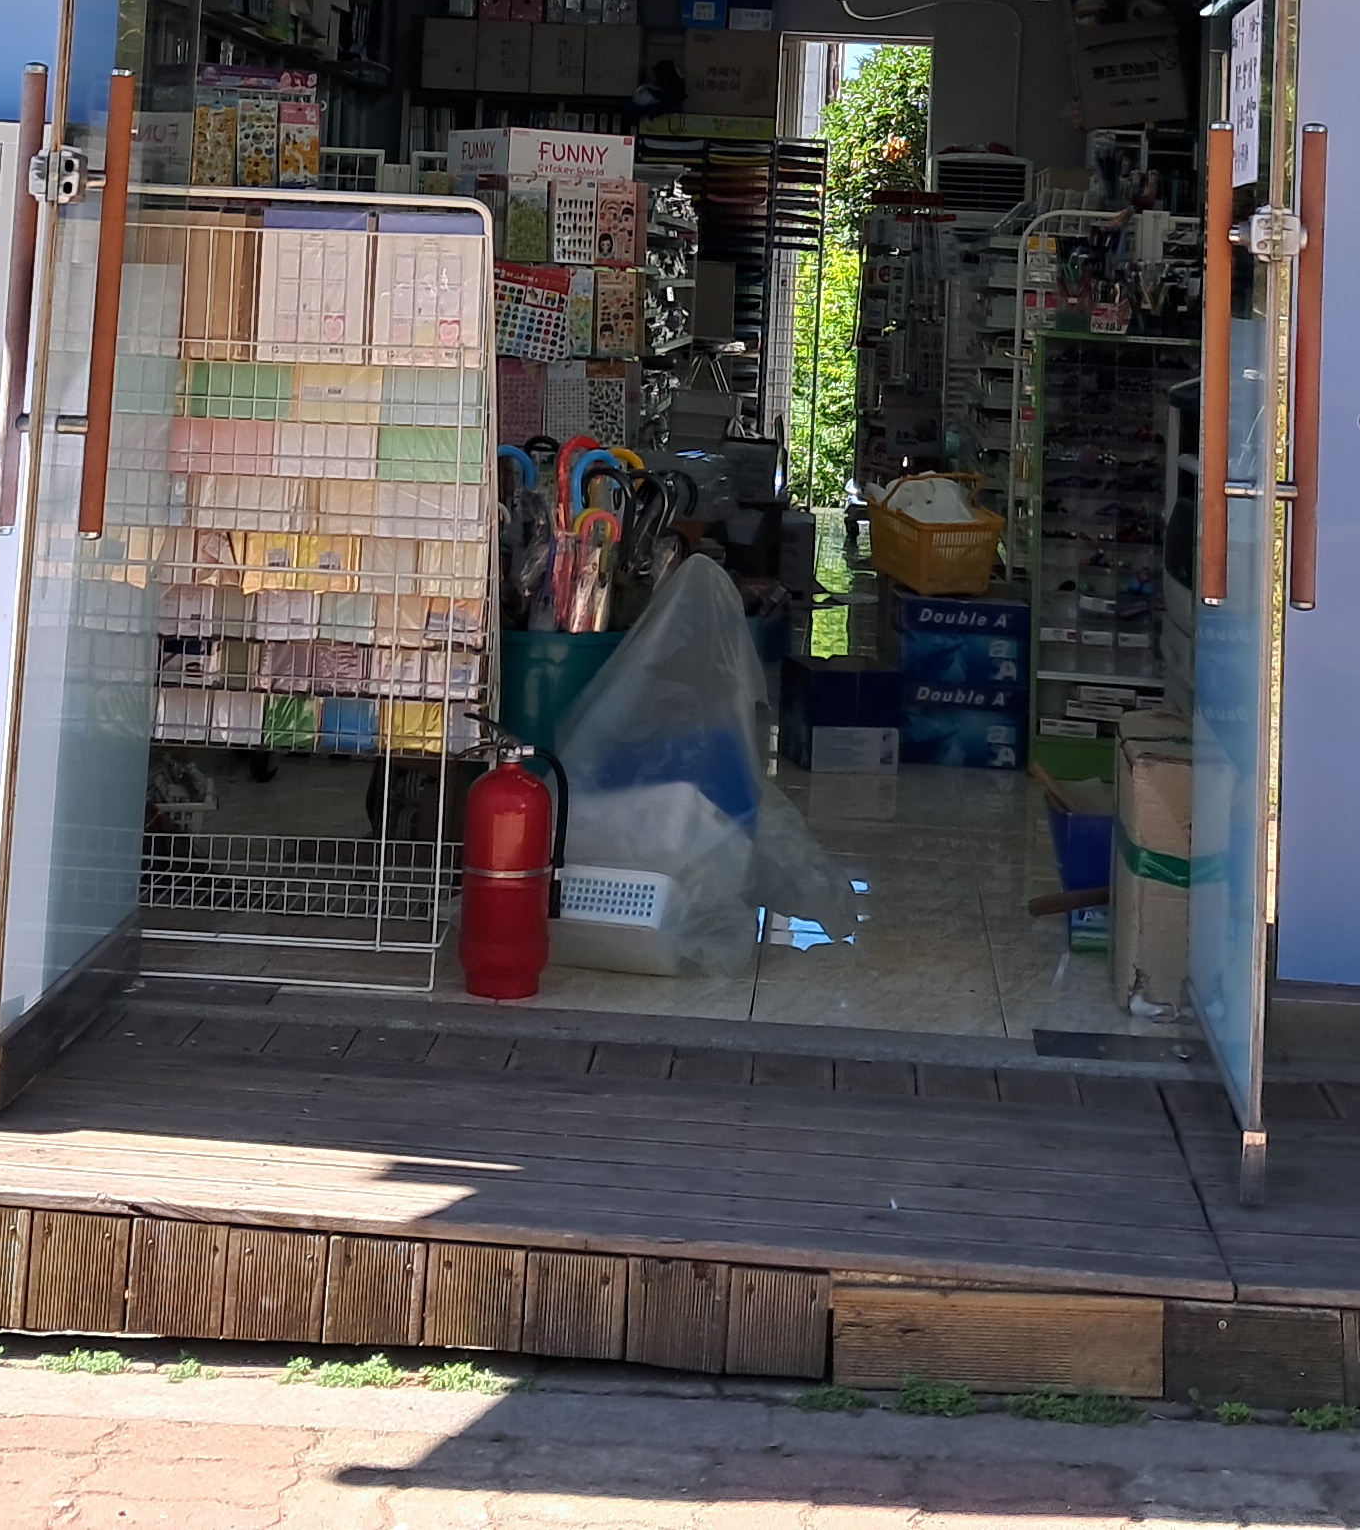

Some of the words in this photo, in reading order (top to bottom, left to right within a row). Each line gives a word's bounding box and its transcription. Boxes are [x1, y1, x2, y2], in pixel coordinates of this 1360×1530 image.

[461, 140, 497, 161] FUNNY
[538, 141, 609, 166] FUNNY
[537, 163, 574, 174] Sticker
[576, 167, 605, 177] World
[919, 608, 987, 627] Double
[994, 613, 1008, 628] A
[916, 686, 985, 705] Double
[991, 692, 1006, 707] A
